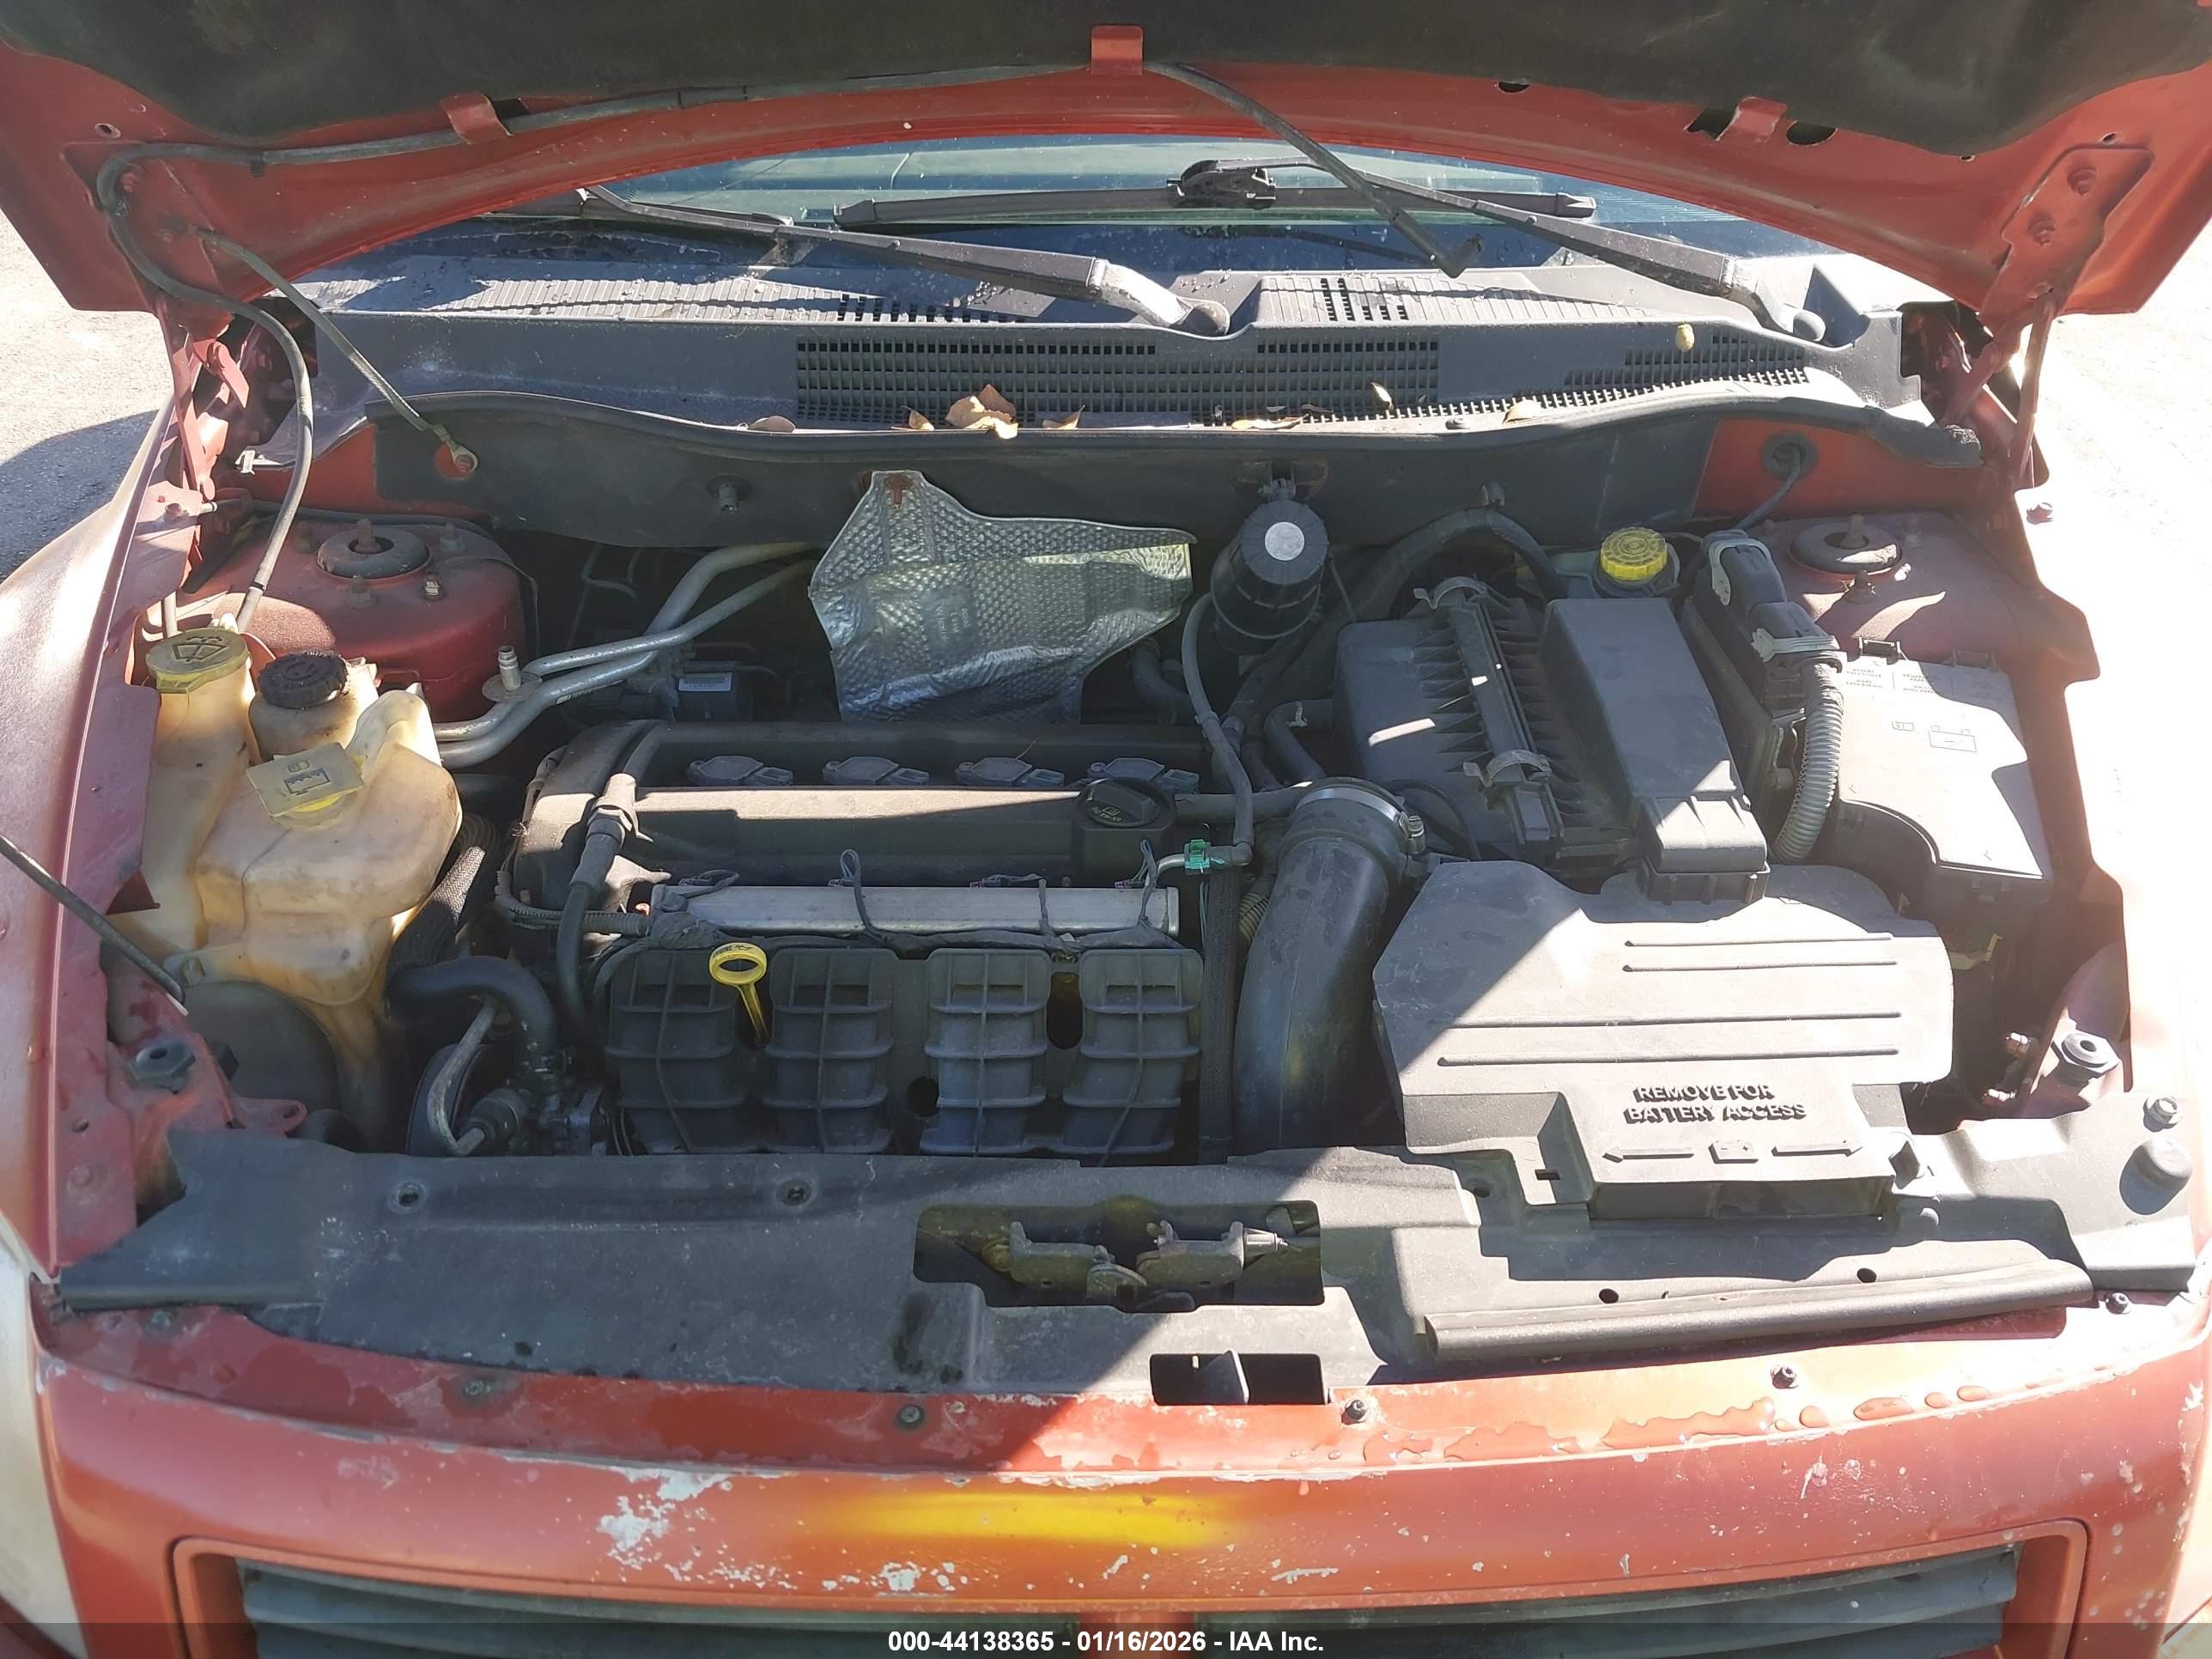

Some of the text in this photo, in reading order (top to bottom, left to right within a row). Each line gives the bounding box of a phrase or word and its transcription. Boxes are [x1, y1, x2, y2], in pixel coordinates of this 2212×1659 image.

[1632, 1085, 1775, 1103] REMOVE FOR
[1623, 1104, 1807, 1124] BATTERY ACCESS
